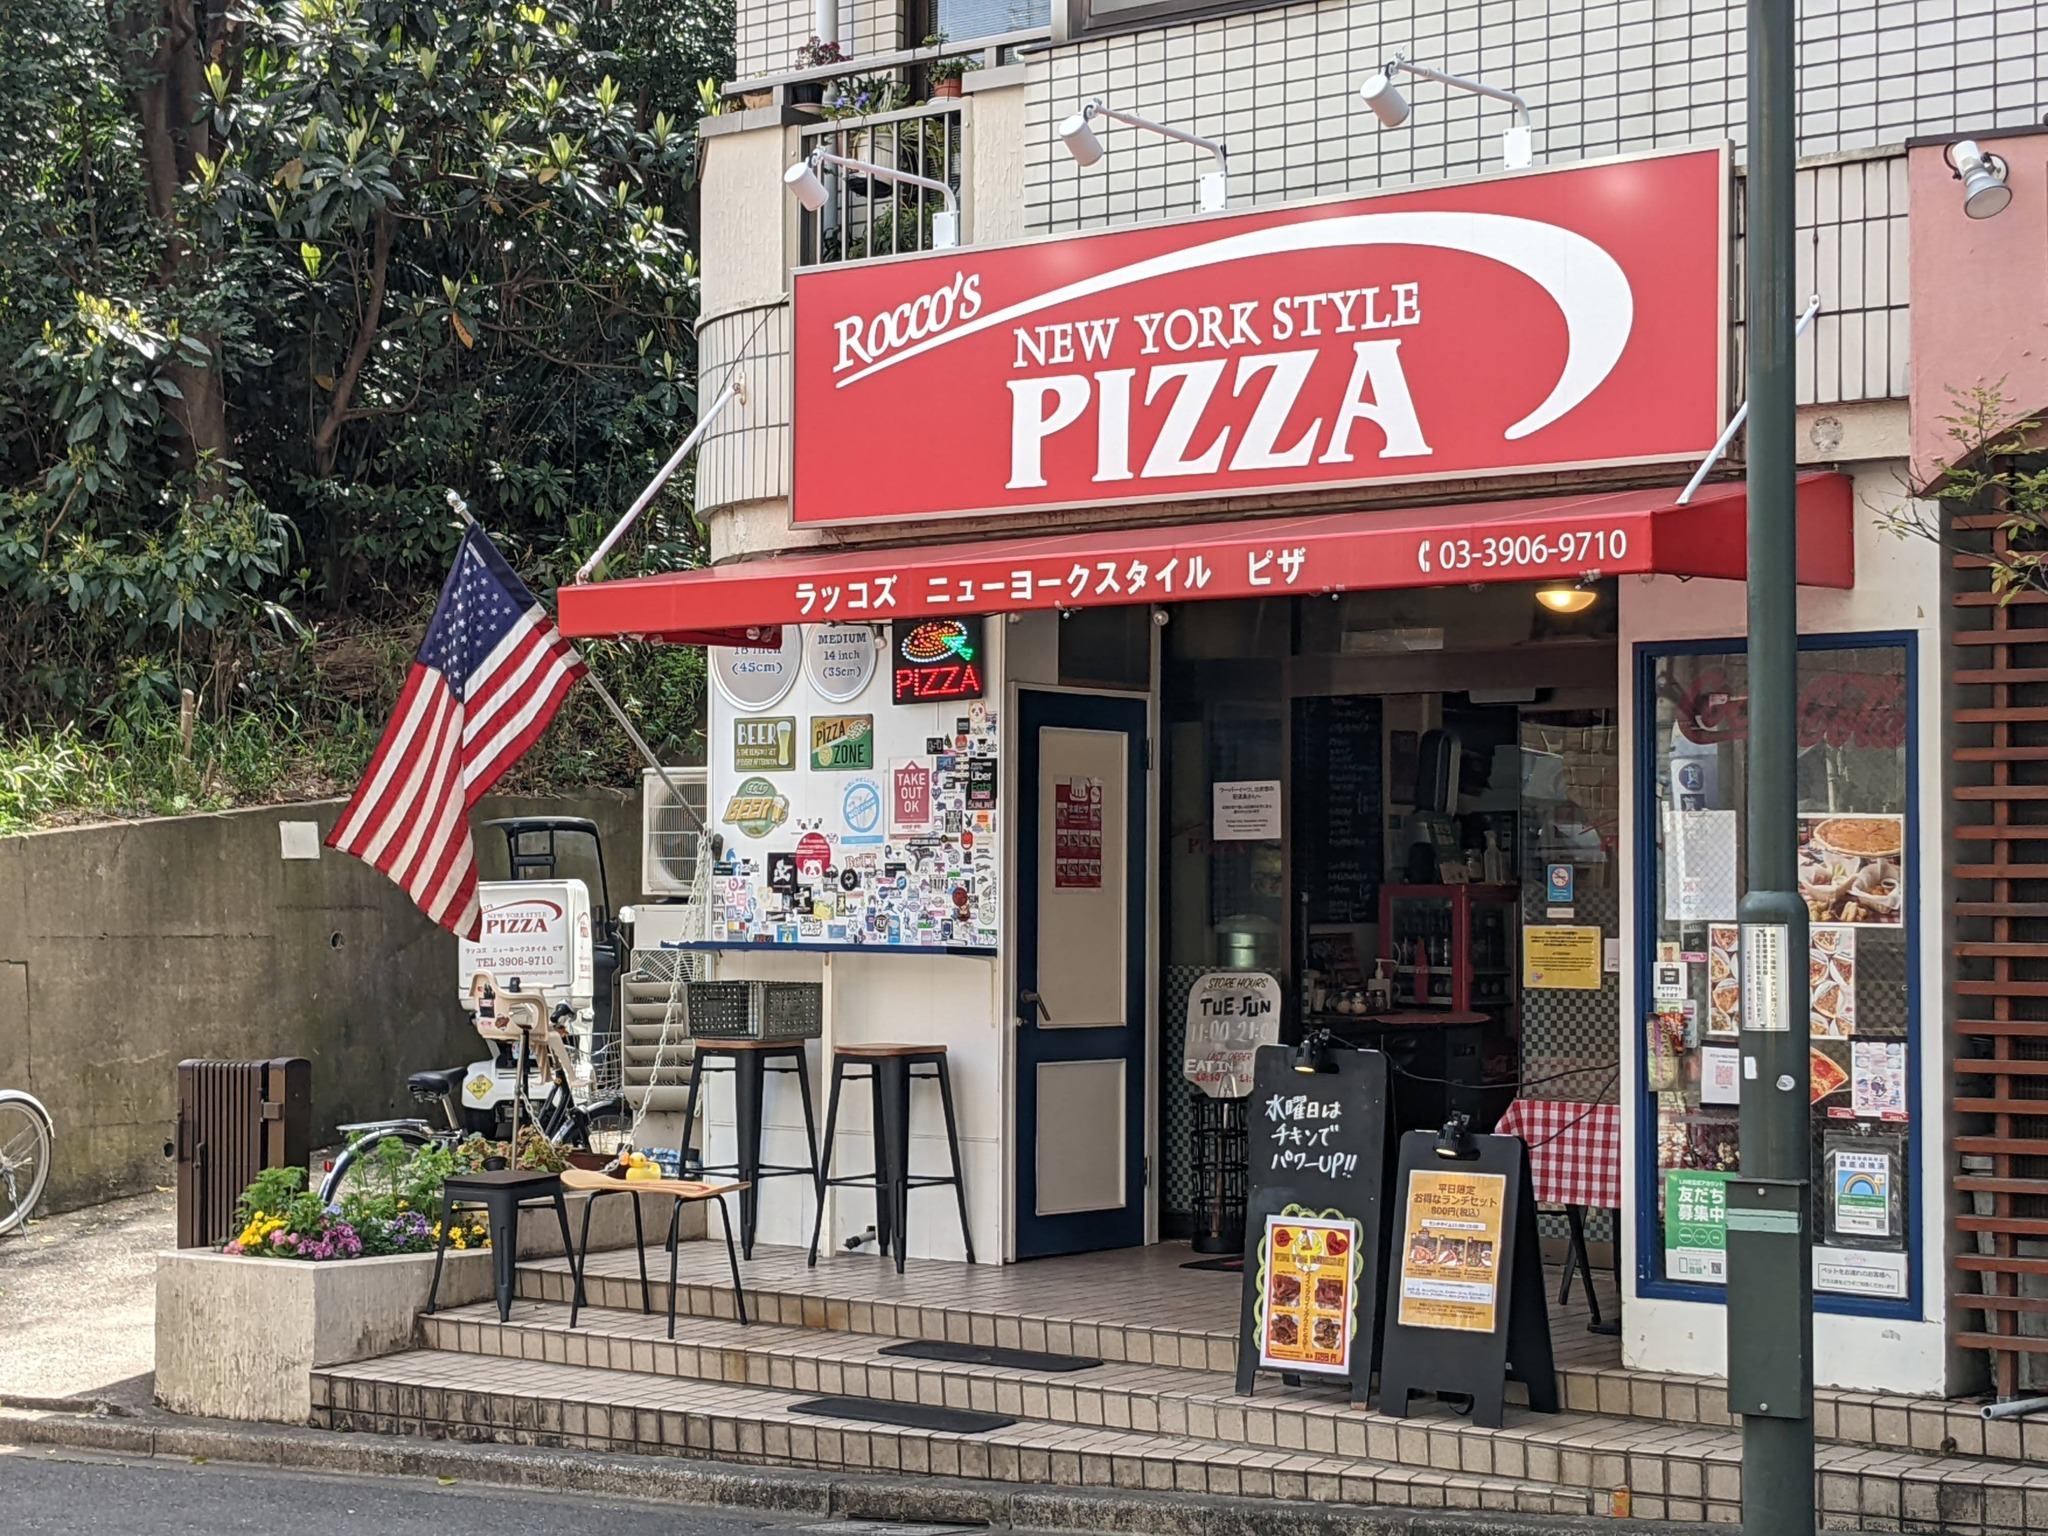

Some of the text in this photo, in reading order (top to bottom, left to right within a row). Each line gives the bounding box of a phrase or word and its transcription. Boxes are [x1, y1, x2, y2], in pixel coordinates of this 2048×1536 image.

[1014, 282, 1422, 369] NEW YORK STYLE
[1005, 339, 1433, 490] PIZZA
[1438, 530, 1627, 571] 03-3906-9710
[794, 547, 1307, 614] ラッコズ ニューヨークスタイル ピザ
[818, 633, 867, 645] MEDIUM
[824, 649, 860, 661] 14 inch
[732, 661, 783, 675] (45cm)
[822, 666, 861, 679] (35cm)
[896, 664, 980, 700] PIZZA
[738, 722, 777, 746] BEER
[816, 720, 846, 748] PIZZA
[834, 744, 865, 764] ZONE
[897, 772, 926, 786] TAKE
[971, 771, 992, 781] Uber
[901, 787, 923, 799] OUT
[725, 797, 773, 822] BEER
[904, 801, 919, 813] OK
[486, 918, 548, 934] PIZZA
[476, 956, 554, 968] TEL 3906-9710
[1208, 977, 1269, 989] STORE HOURS
[1184, 1059, 1215, 1073] EAT
[1265, 1094, 1342, 1122] 水曜日は
[1271, 1123, 1340, 1147] チキンで
[1438, 1184, 1476, 1195] 平日限定
[1678, 1186, 1725, 1204] 友だち
[1414, 1193, 1497, 1208] お得なランチセット
[1678, 1204, 1725, 1223] 募集中
